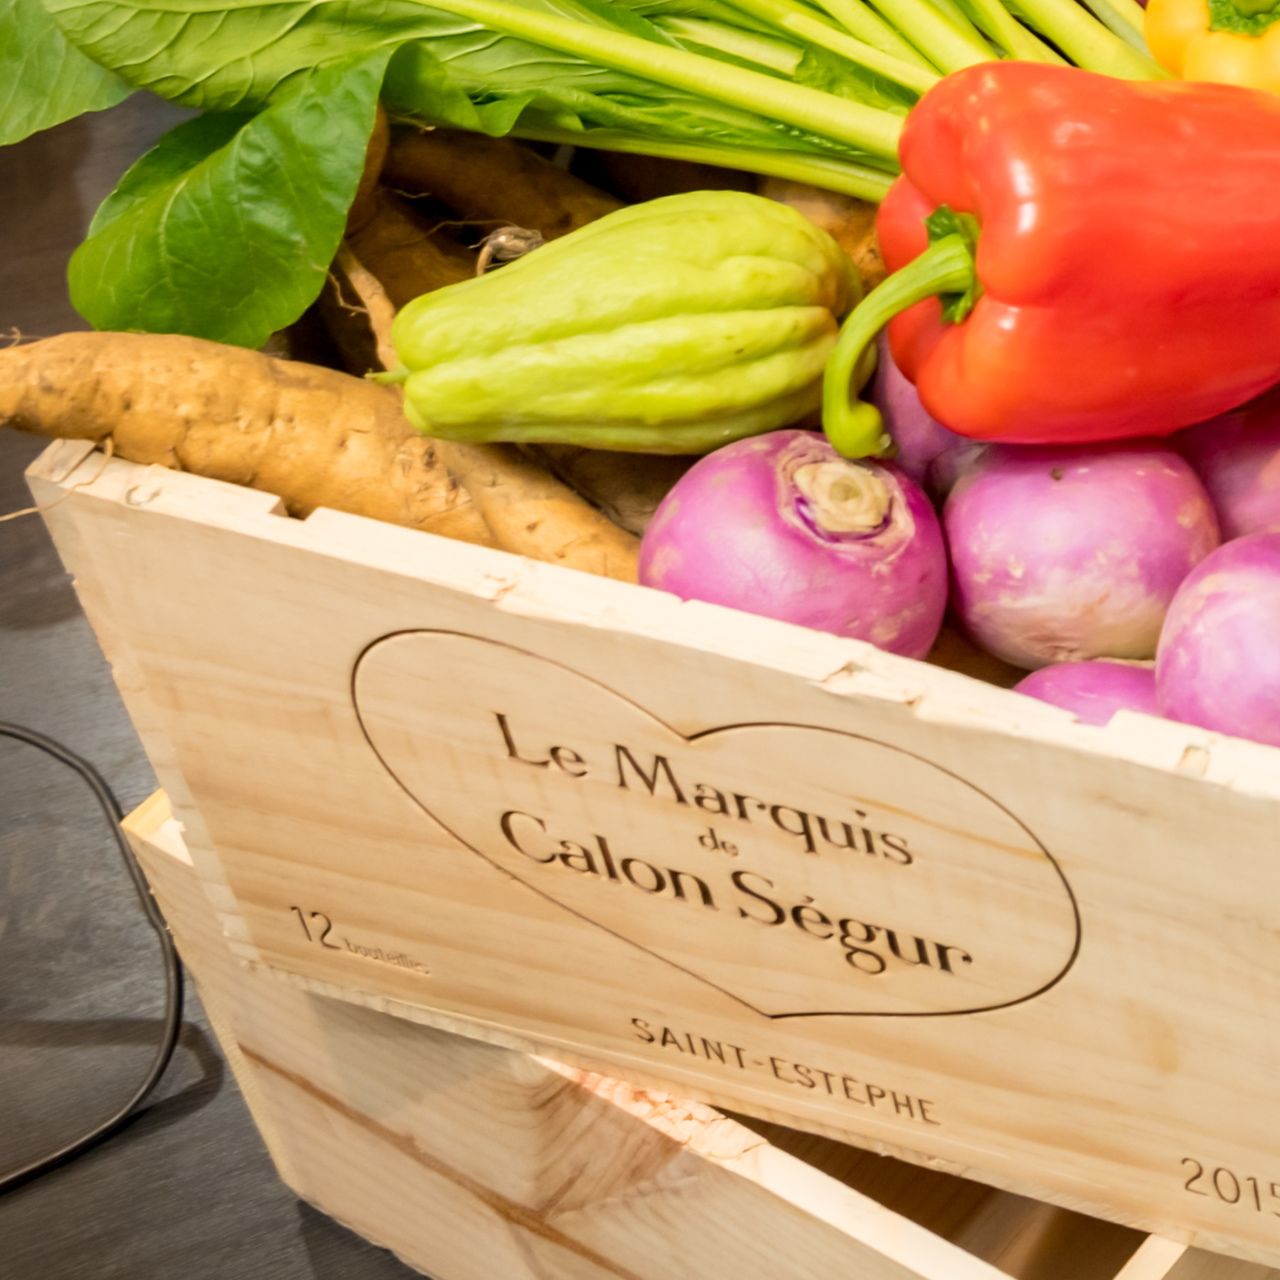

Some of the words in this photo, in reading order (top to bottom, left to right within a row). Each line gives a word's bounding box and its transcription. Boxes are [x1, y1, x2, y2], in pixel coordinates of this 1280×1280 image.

[494, 712, 589, 778] Le
[613, 742, 914, 867] Marquis
[499, 808, 720, 912] Calon
[729, 868, 974, 976] Ségur
[697, 826, 740, 858] de
[290, 905, 343, 951] 12
